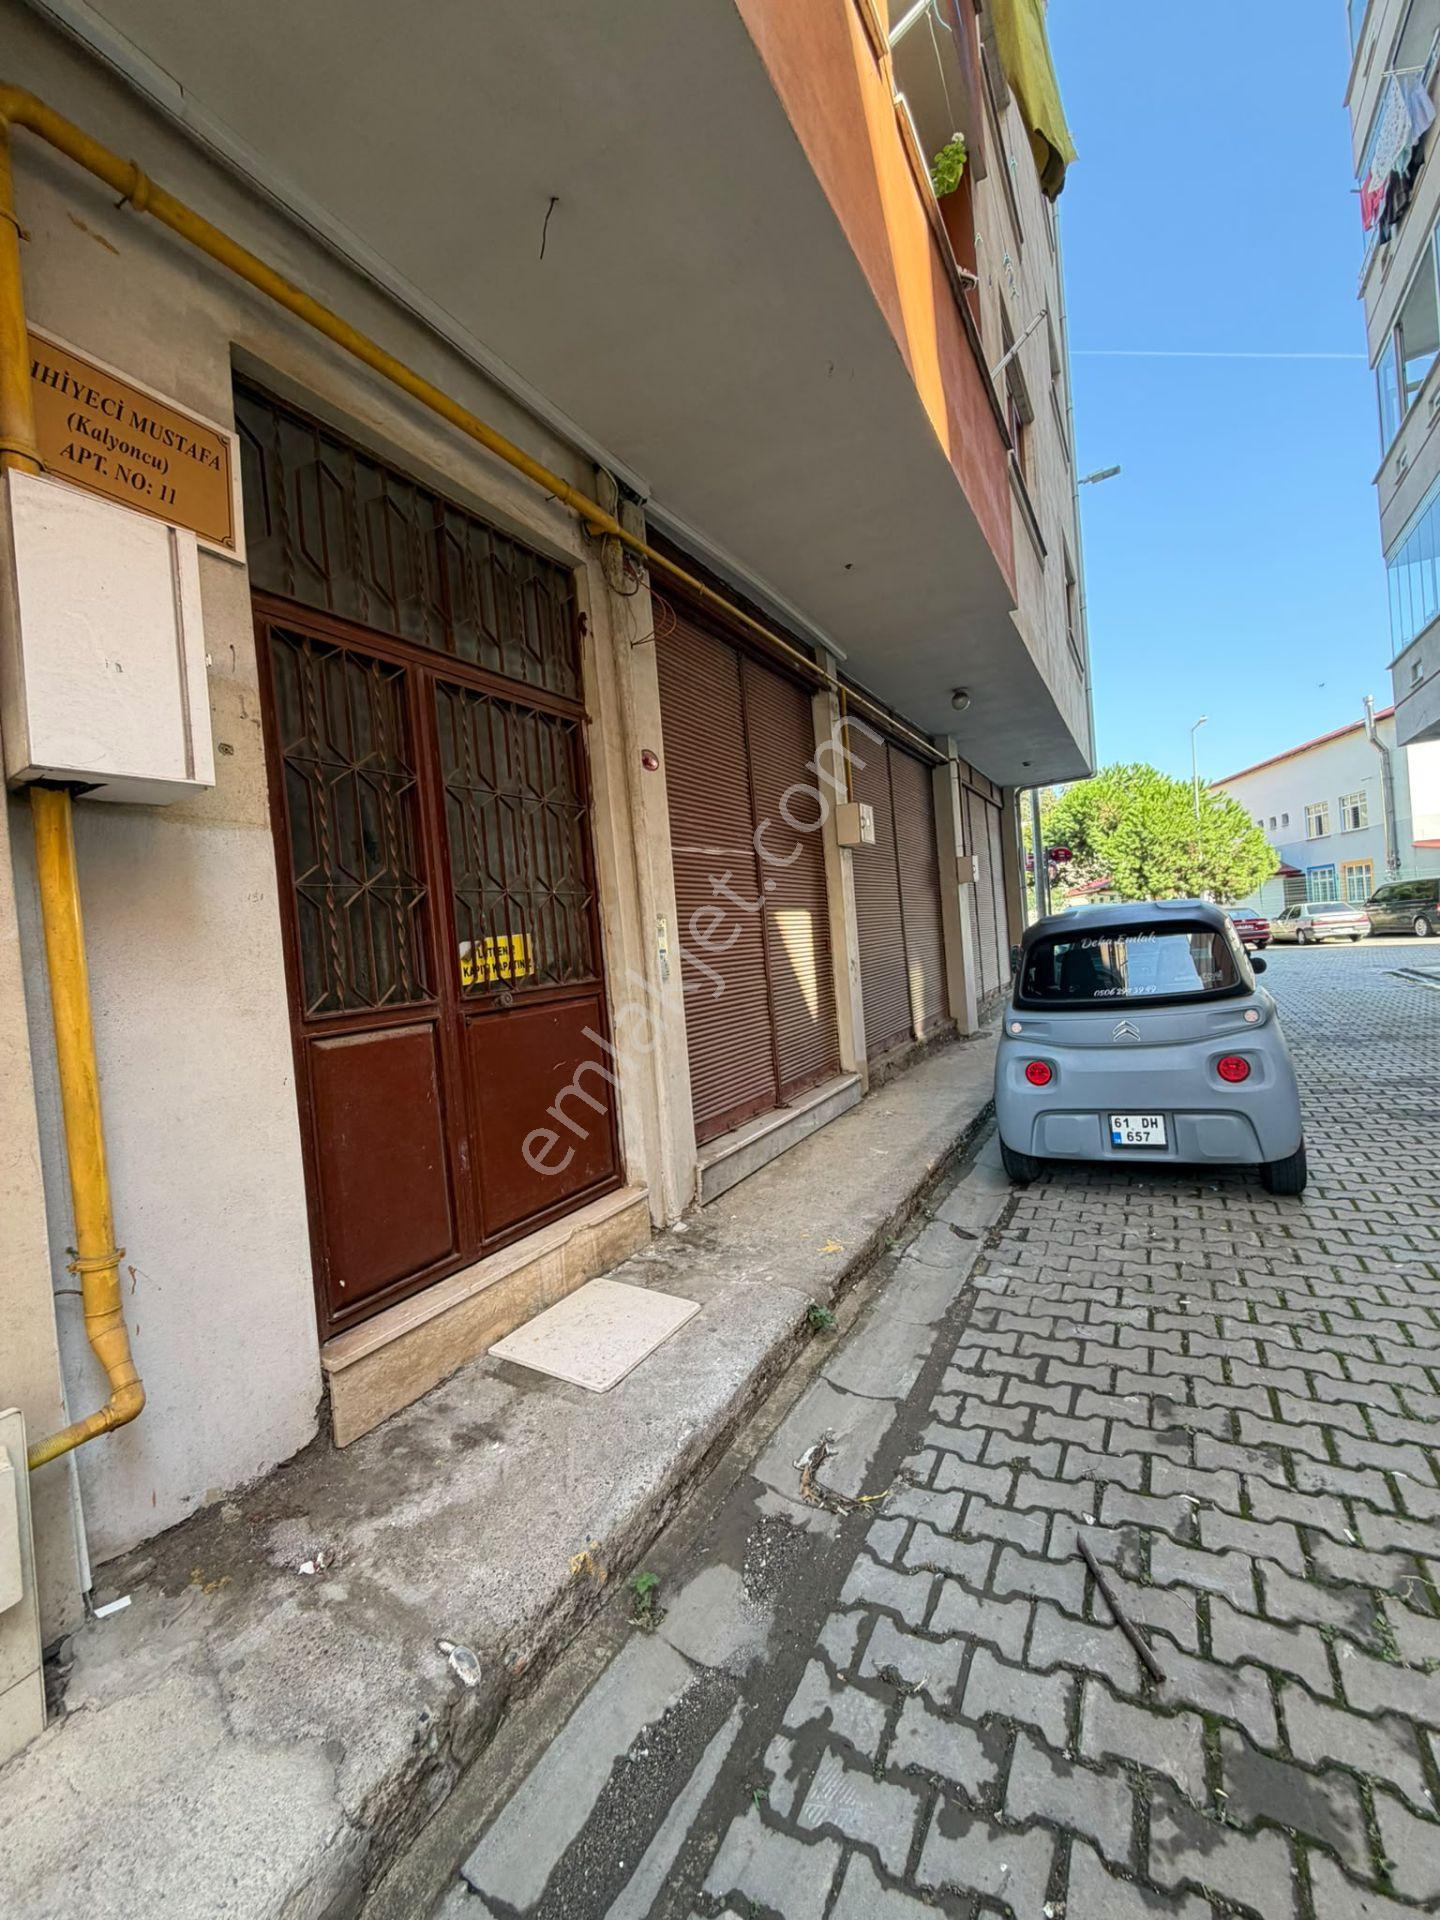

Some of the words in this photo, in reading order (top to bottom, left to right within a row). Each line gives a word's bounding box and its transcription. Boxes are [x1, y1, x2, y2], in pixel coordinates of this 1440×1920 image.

[66, 411, 169, 475] (Kalyoncu)
[129, 410, 221, 471] MUSTAFA
[60, 442, 108, 476] APT.
[114, 463, 152, 495] NO:
[160, 484, 176, 505] 11
[1114, 931, 1157, 945] Emlak
[1114, 1117, 1130, 1128] 61
[1141, 1117, 1159, 1129] DH
[1127, 1131, 1151, 1142] 657
